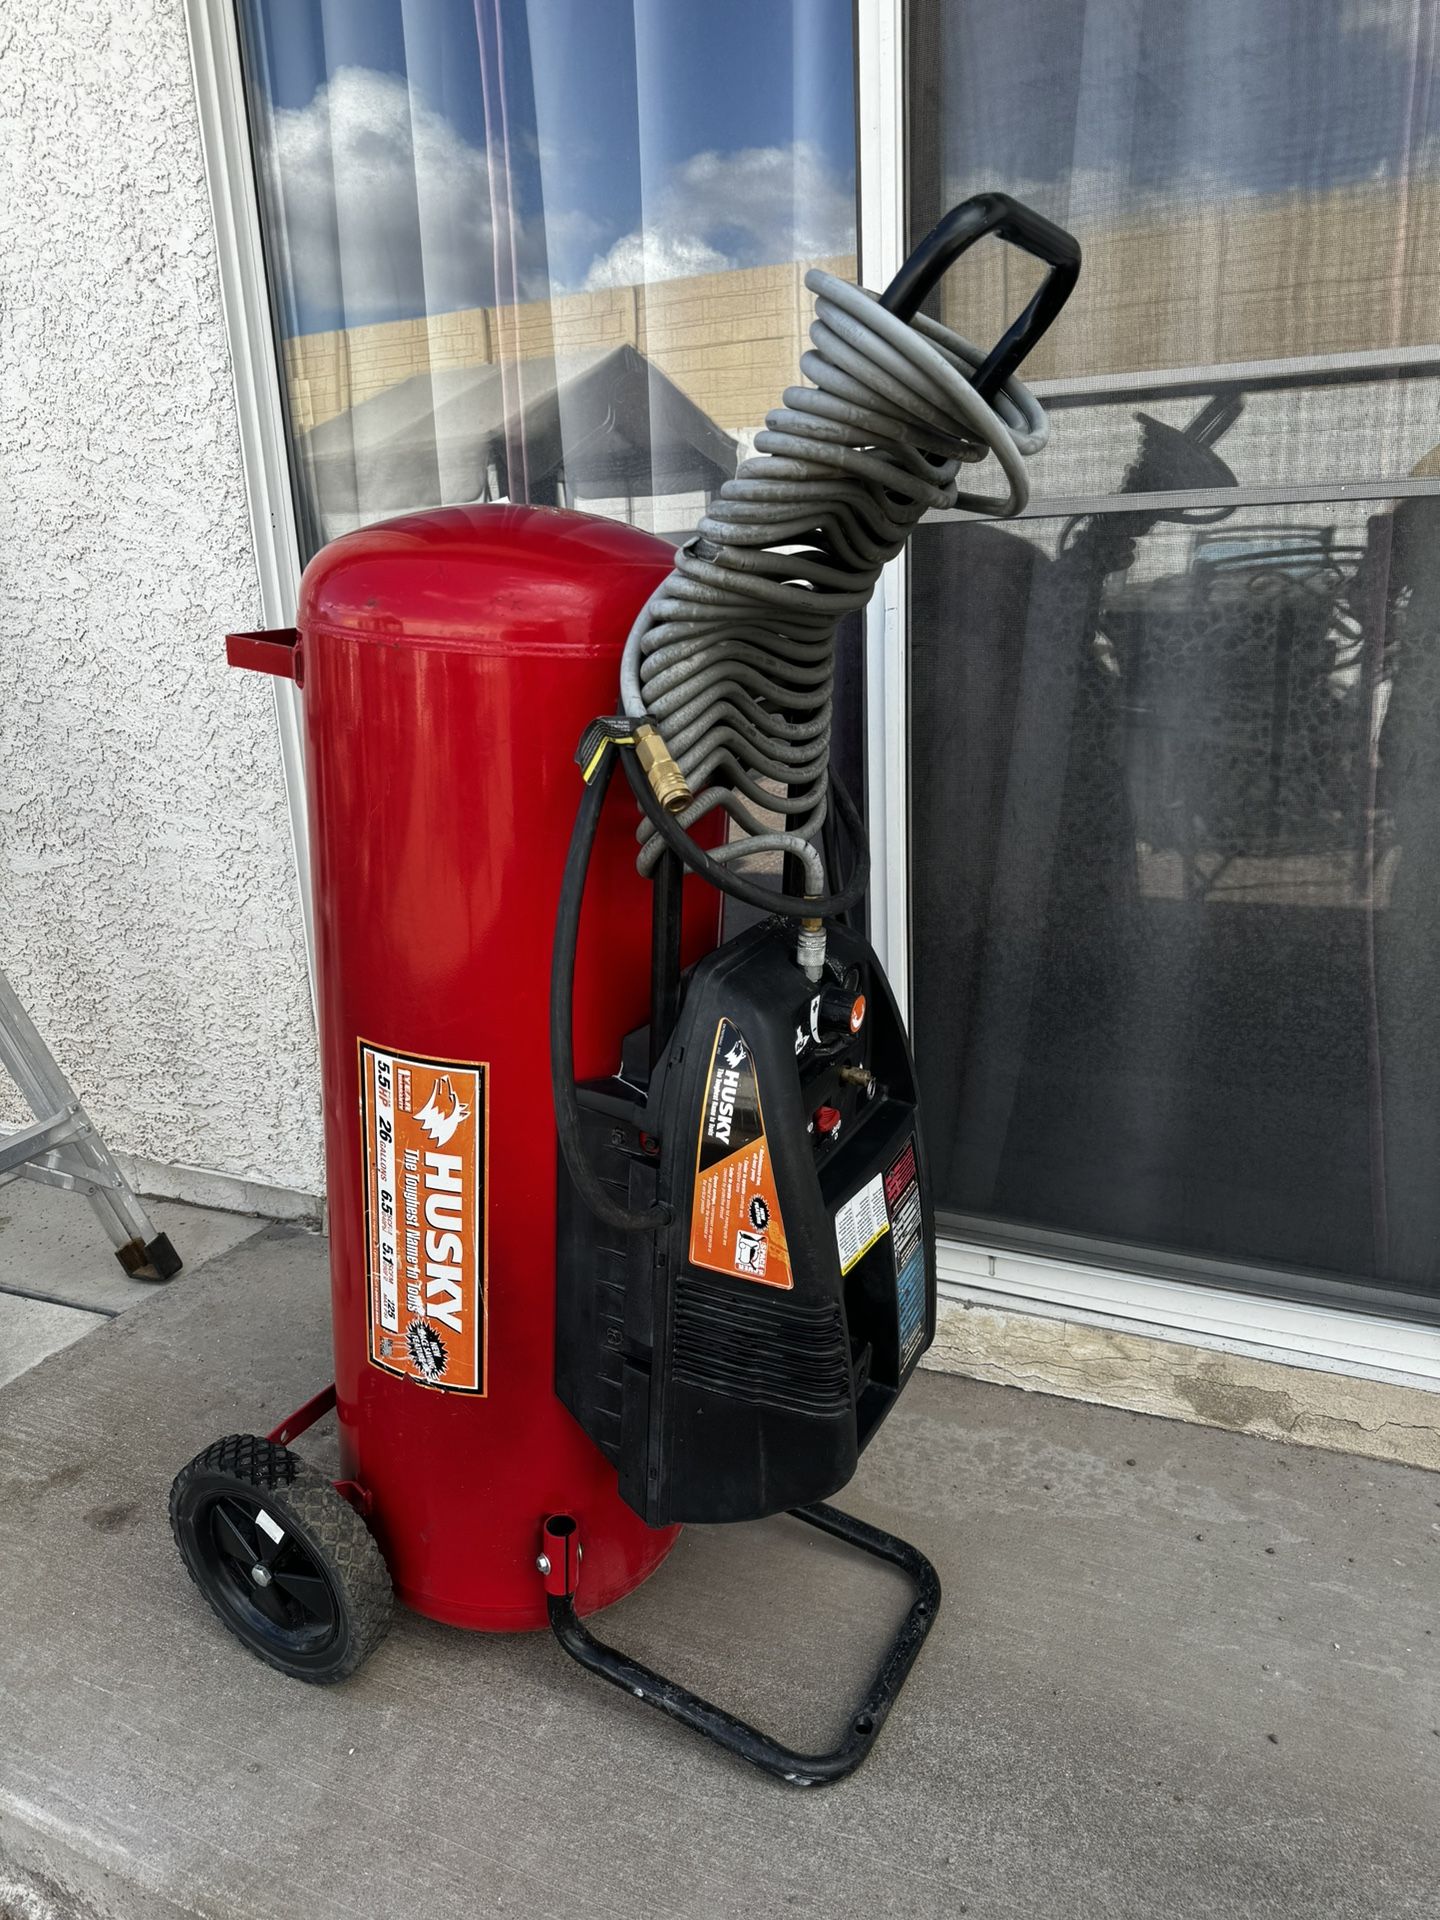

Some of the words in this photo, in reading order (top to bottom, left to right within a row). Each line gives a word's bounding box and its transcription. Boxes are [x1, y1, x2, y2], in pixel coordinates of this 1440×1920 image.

[378, 1060, 391, 1091] 5.5
[378, 1085, 388, 1108] HP
[404, 1074, 412, 1112] YEAR
[712, 1078, 721, 1100] Toughest
[710, 1101, 718, 1116] Name
[715, 1070, 739, 1145] HUSKY
[379, 1116, 392, 1143] 26
[404, 1149, 419, 1172] The
[381, 1190, 392, 1216] 6.5
[404, 1173, 420, 1227] Toughest
[753, 1201, 761, 1224] FEATURE
[382, 1243, 393, 1265] 5.1
[406, 1230, 421, 1265] Name
[424, 1151, 462, 1334] HUSKY
[758, 1242, 767, 1267] SPACE
[387, 1299, 395, 1320] 125
[407, 1281, 422, 1313] Tools
[429, 1341, 441, 1357] NEW
